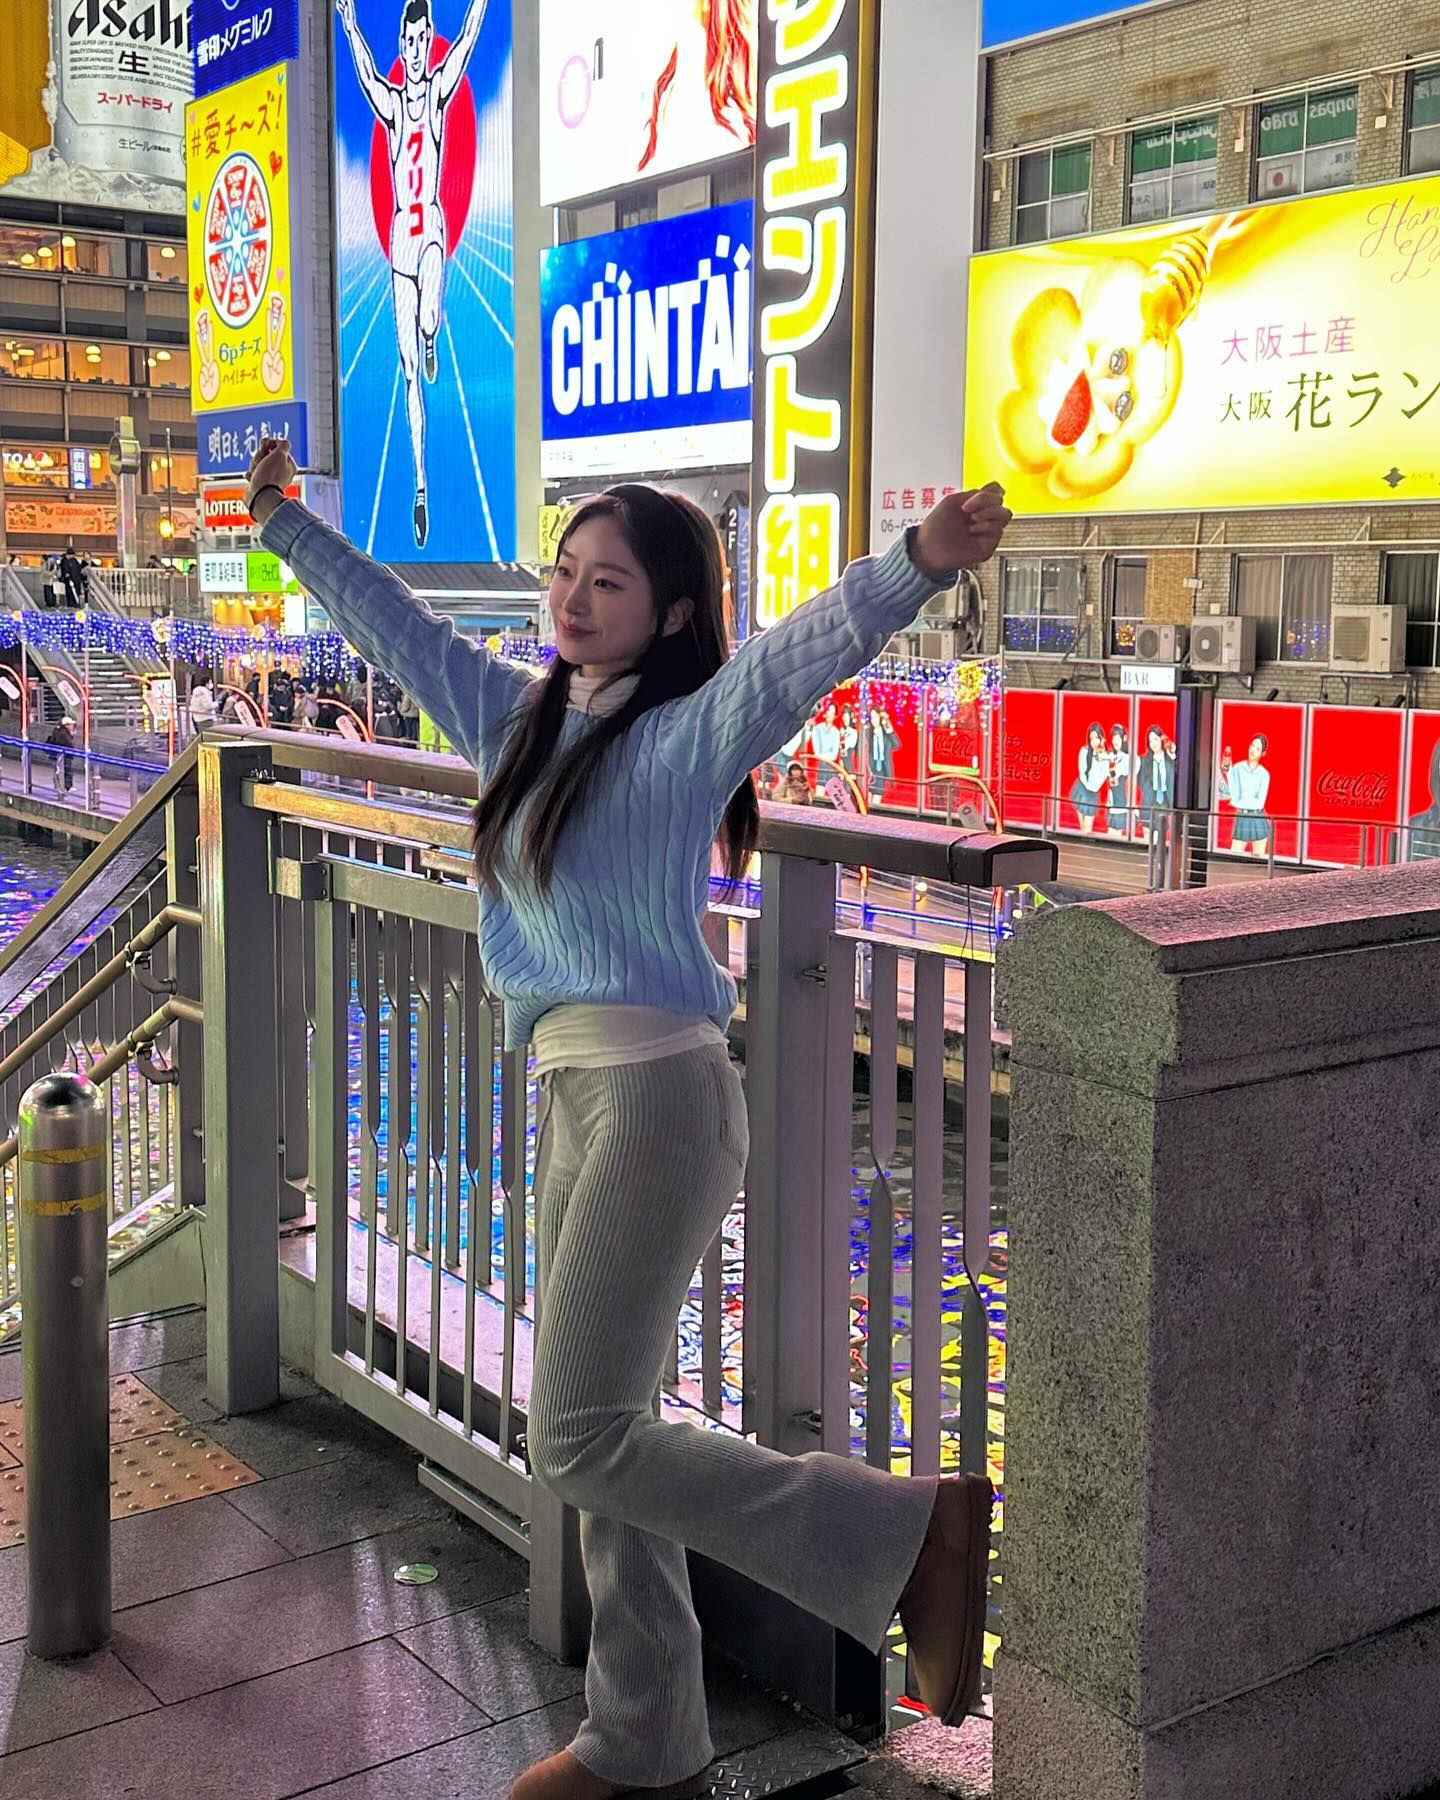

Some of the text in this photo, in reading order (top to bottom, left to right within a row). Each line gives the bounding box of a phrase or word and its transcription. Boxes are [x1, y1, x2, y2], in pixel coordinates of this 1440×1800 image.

[196, 7, 272, 67] 雪印メグミルク
[118, 50, 150, 75] 生
[97, 92, 174, 113] スーパードライ
[407, 123, 425, 237] グリコ
[551, 236, 750, 416] CHINTAI
[1221, 315, 1356, 366] 大阪土産
[1123, 671, 1150, 686] BAR
[1317, 768, 1388, 801] Coca-Cola
